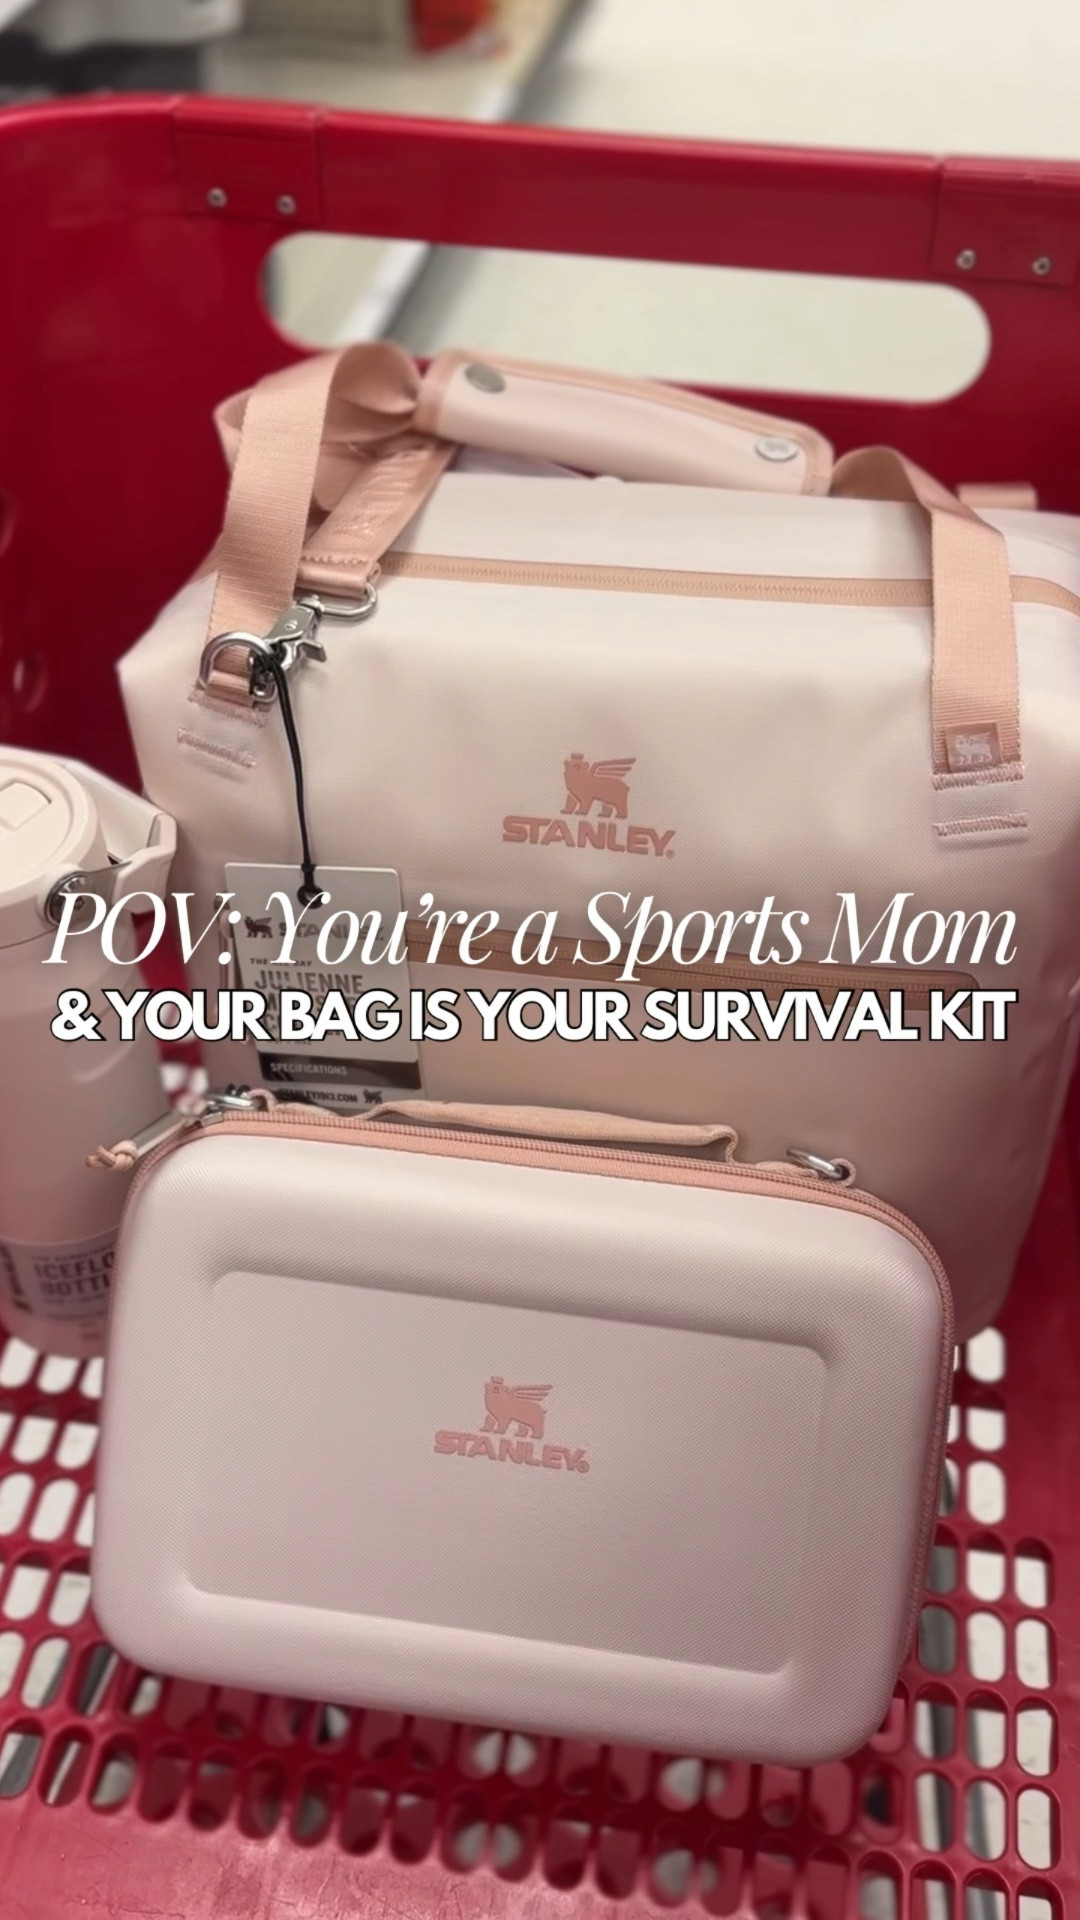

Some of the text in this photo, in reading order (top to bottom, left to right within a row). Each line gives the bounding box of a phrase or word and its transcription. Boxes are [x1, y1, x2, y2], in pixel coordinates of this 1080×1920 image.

[502, 815, 675, 857] STANLEY
[254, 970, 364, 994] JULIENNE
[270, 1062, 348, 1076] SPECIFICATIONS
[434, 1430, 586, 1471] STANLEY
